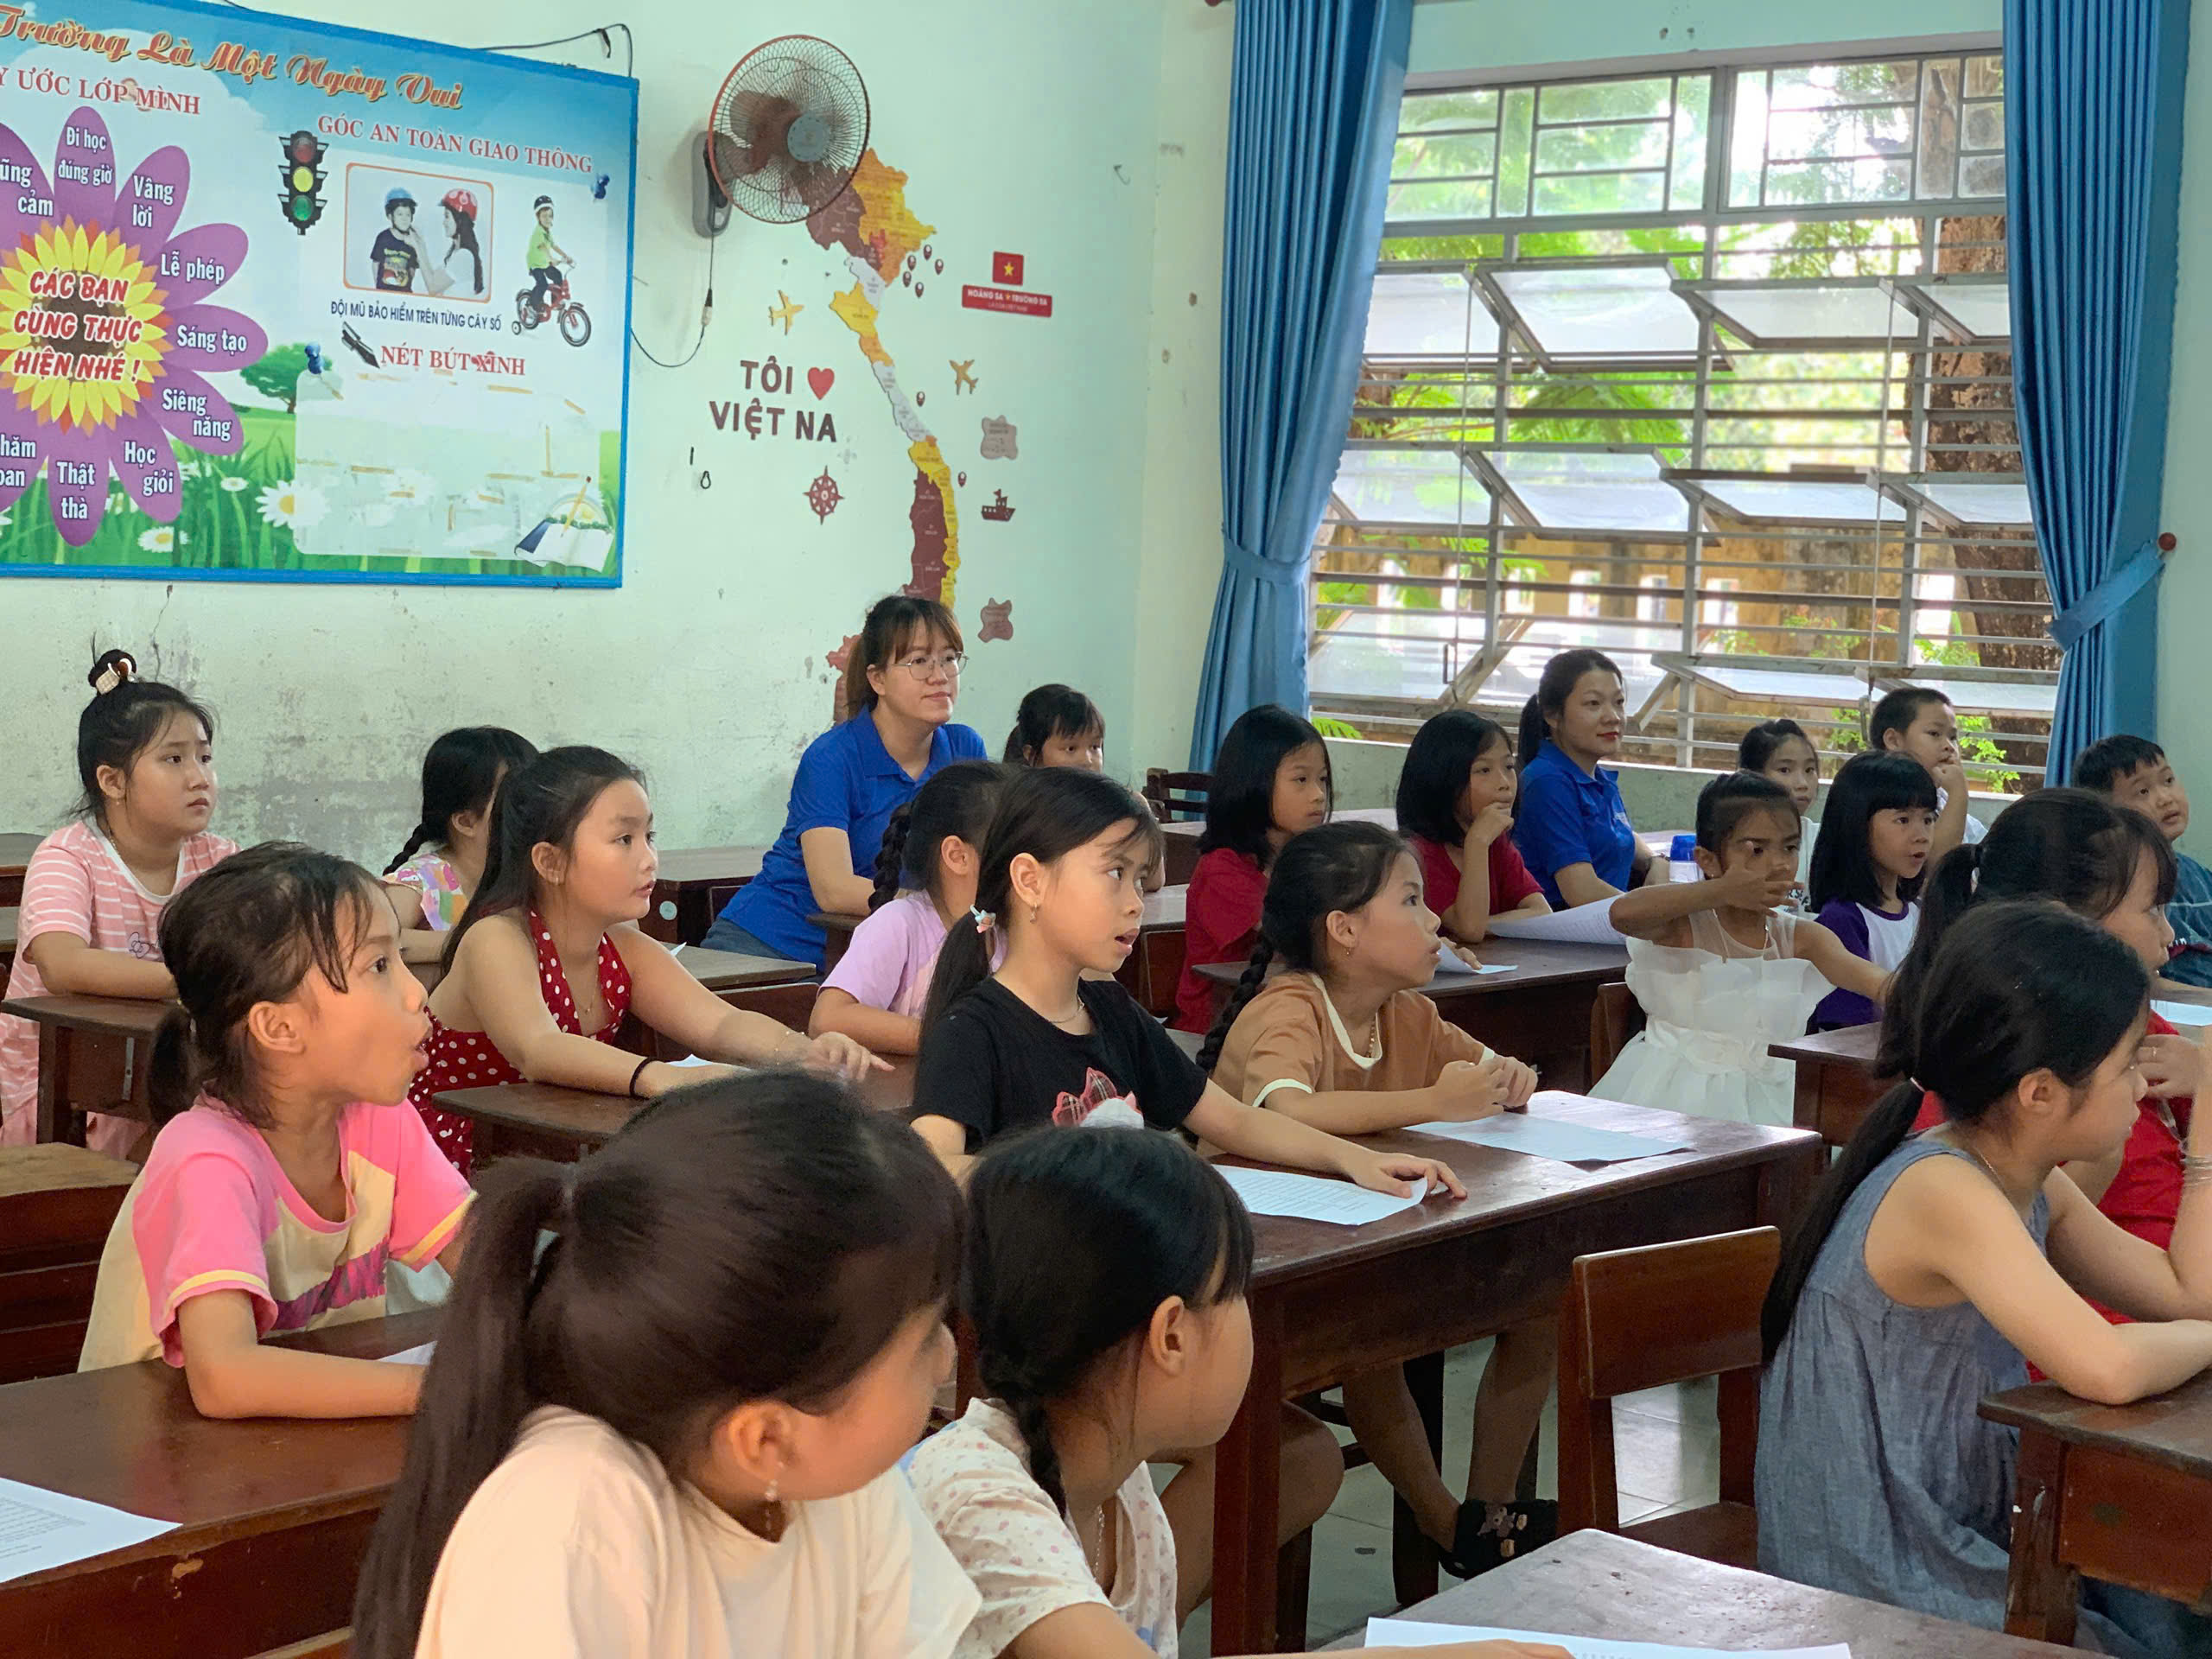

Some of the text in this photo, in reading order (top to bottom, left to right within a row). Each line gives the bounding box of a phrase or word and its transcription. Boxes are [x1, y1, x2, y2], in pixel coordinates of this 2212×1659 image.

[0, 4, 463, 110] Trường Là Một Ngày Vui
[17, 67, 70, 95] ƯỚC
[79, 77, 128, 103] LỚP
[136, 85, 200, 115] MÌNH
[66, 127, 106, 152] Đi học
[318, 113, 593, 173] GÓC AN TOÀN GIAO THÔNG
[58, 159, 112, 187] đúng giờ
[17, 189, 54, 216] cảm
[133, 175, 174, 205] Vâng
[132, 205, 152, 227] lời
[161, 251, 225, 282] Lễ phép
[29, 269, 129, 306] CÁC BẠN
[14, 305, 143, 347] CÙNG THỰC
[331, 300, 501, 331] ĐỘI MŨ BẢO HIỂM TRÊN TỪNG CÂY SỐ
[176, 325, 247, 355] Sáng tạo
[13, 347, 72, 381] HIỆN
[76, 352, 124, 381] NHÉ
[381, 342, 423, 367] NÉT
[429, 346, 472, 372] BÚT
[740, 355, 793, 395] TÔI
[162, 388, 207, 416] Siêng
[193, 416, 232, 442] năng
[709, 397, 836, 442] VIỆT NA
[124, 441, 156, 468] Học
[55, 461, 96, 491] Thật
[143, 469, 173, 497] giỏi
[60, 497, 88, 519] thà
